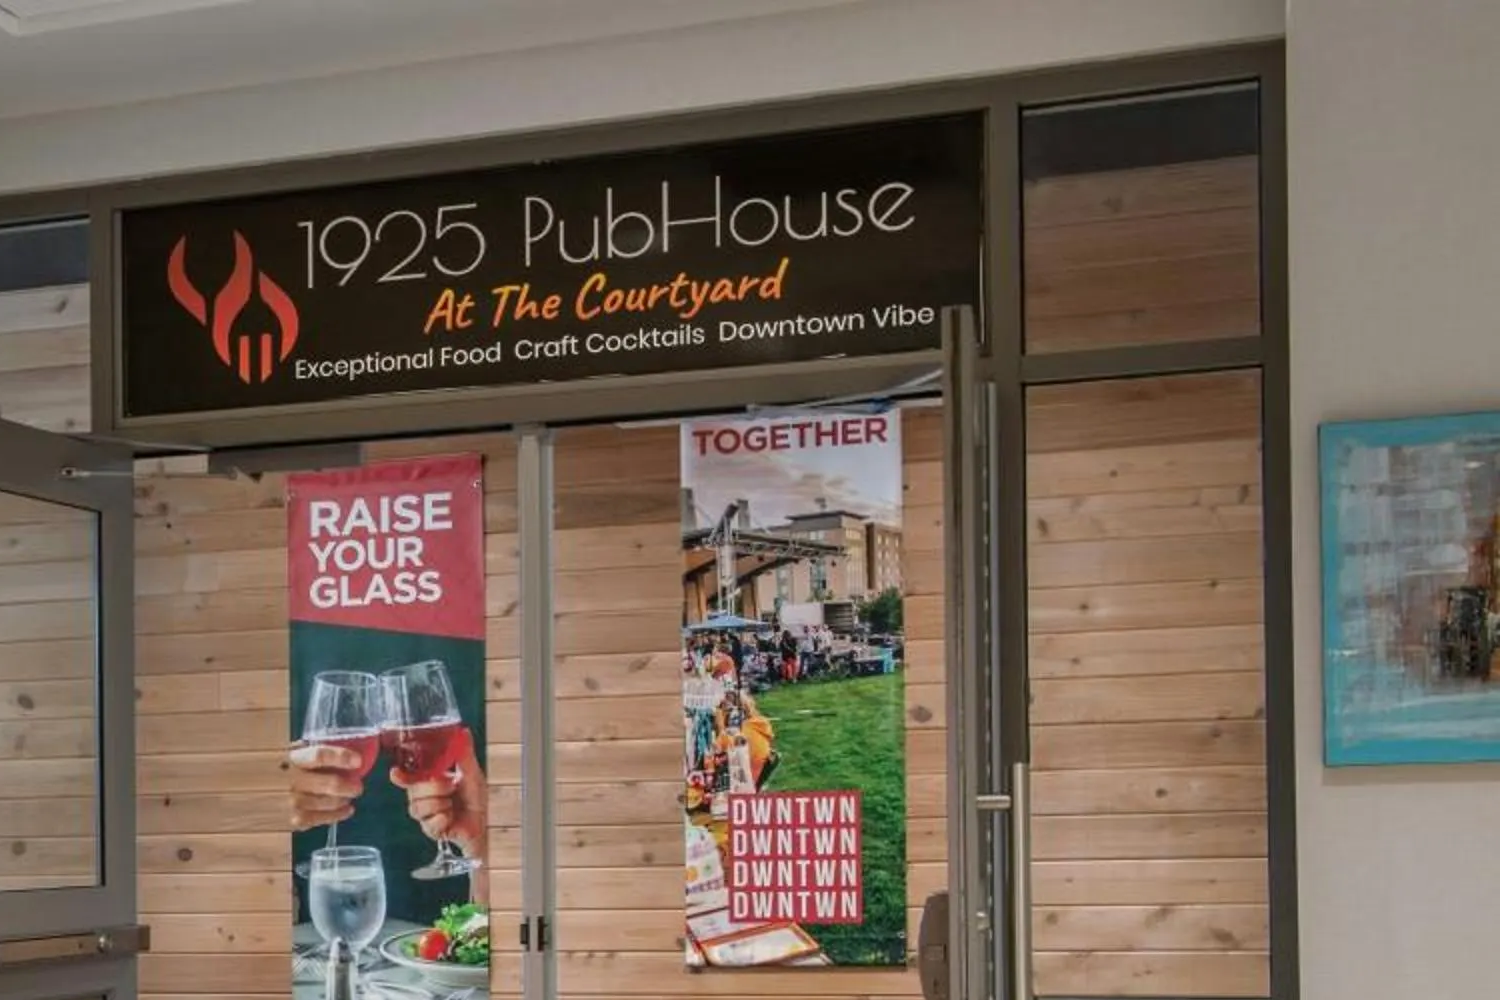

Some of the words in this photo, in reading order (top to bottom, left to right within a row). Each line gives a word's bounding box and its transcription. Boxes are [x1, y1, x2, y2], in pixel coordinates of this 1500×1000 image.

[297, 203, 486, 288] 1925
[525, 175, 915, 267] PubHouse
[424, 288, 475, 335] At
[491, 282, 562, 328] The
[575, 257, 790, 320] Courtyard
[295, 348, 433, 381] Exceptional
[441, 342, 501, 367] Food
[515, 335, 579, 360] Craft
[586, 324, 705, 353] Cocktails
[719, 312, 865, 342] Downtown
[872, 304, 935, 329] Vibe
[693, 417, 888, 455] TOGETHER
[309, 492, 453, 537] RAISE
[309, 536, 424, 573] YOUR
[309, 571, 443, 609] GLASS
[733, 796, 855, 825] DWNTWN
[733, 828, 856, 856] DWNTWN
[733, 859, 857, 887] DWNTWN
[733, 891, 857, 918] DWNTWN
